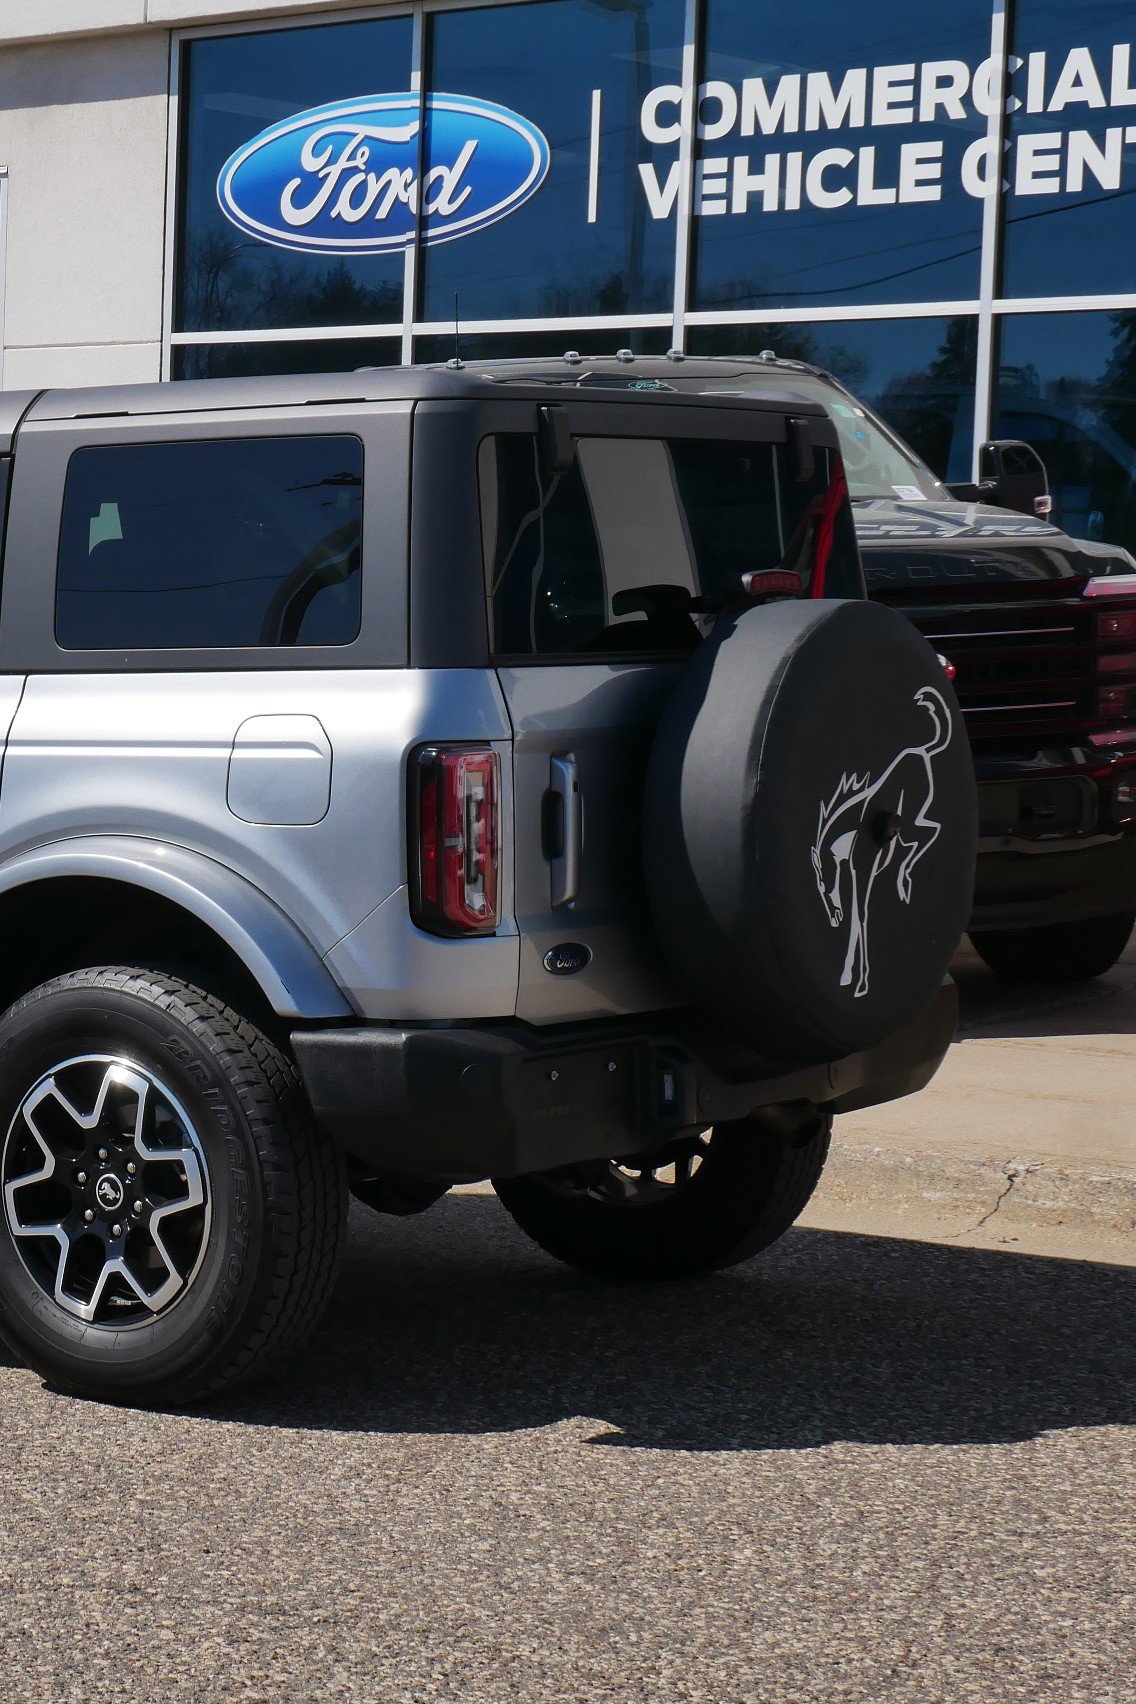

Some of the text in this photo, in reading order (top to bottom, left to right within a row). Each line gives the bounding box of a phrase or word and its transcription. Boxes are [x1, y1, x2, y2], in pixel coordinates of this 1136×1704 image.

[640, 44, 1136, 144] COMMERCIAL
[280, 120, 478, 226] Ford
[638, 126, 1136, 219] VEHICLE CEN
